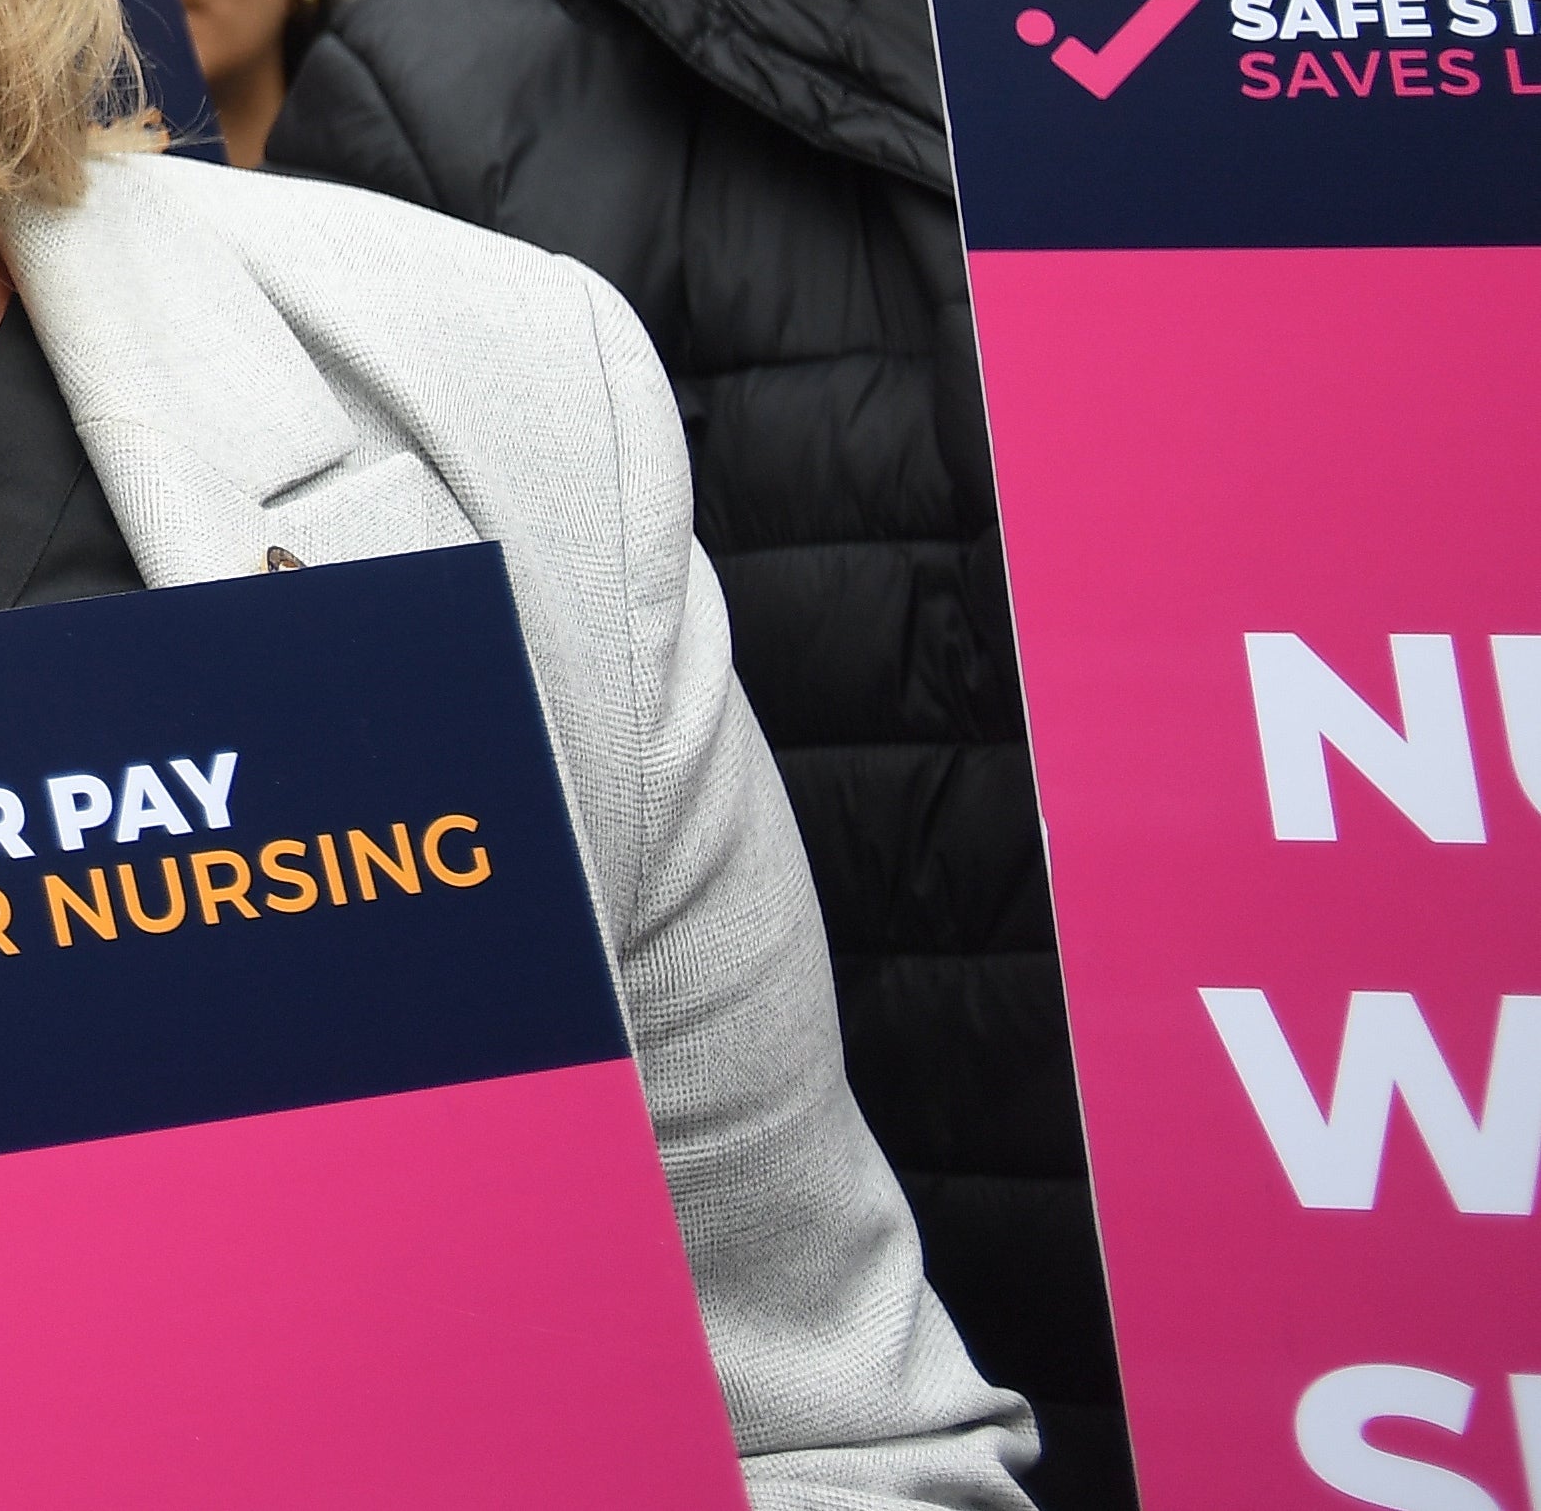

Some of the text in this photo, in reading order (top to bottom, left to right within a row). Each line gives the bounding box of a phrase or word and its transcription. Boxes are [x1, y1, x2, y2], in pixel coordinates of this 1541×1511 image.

[1237, 47, 1483, 102] SAVES
[45, 751, 240, 854] PAY
[42, 812, 493, 949] NURSING
